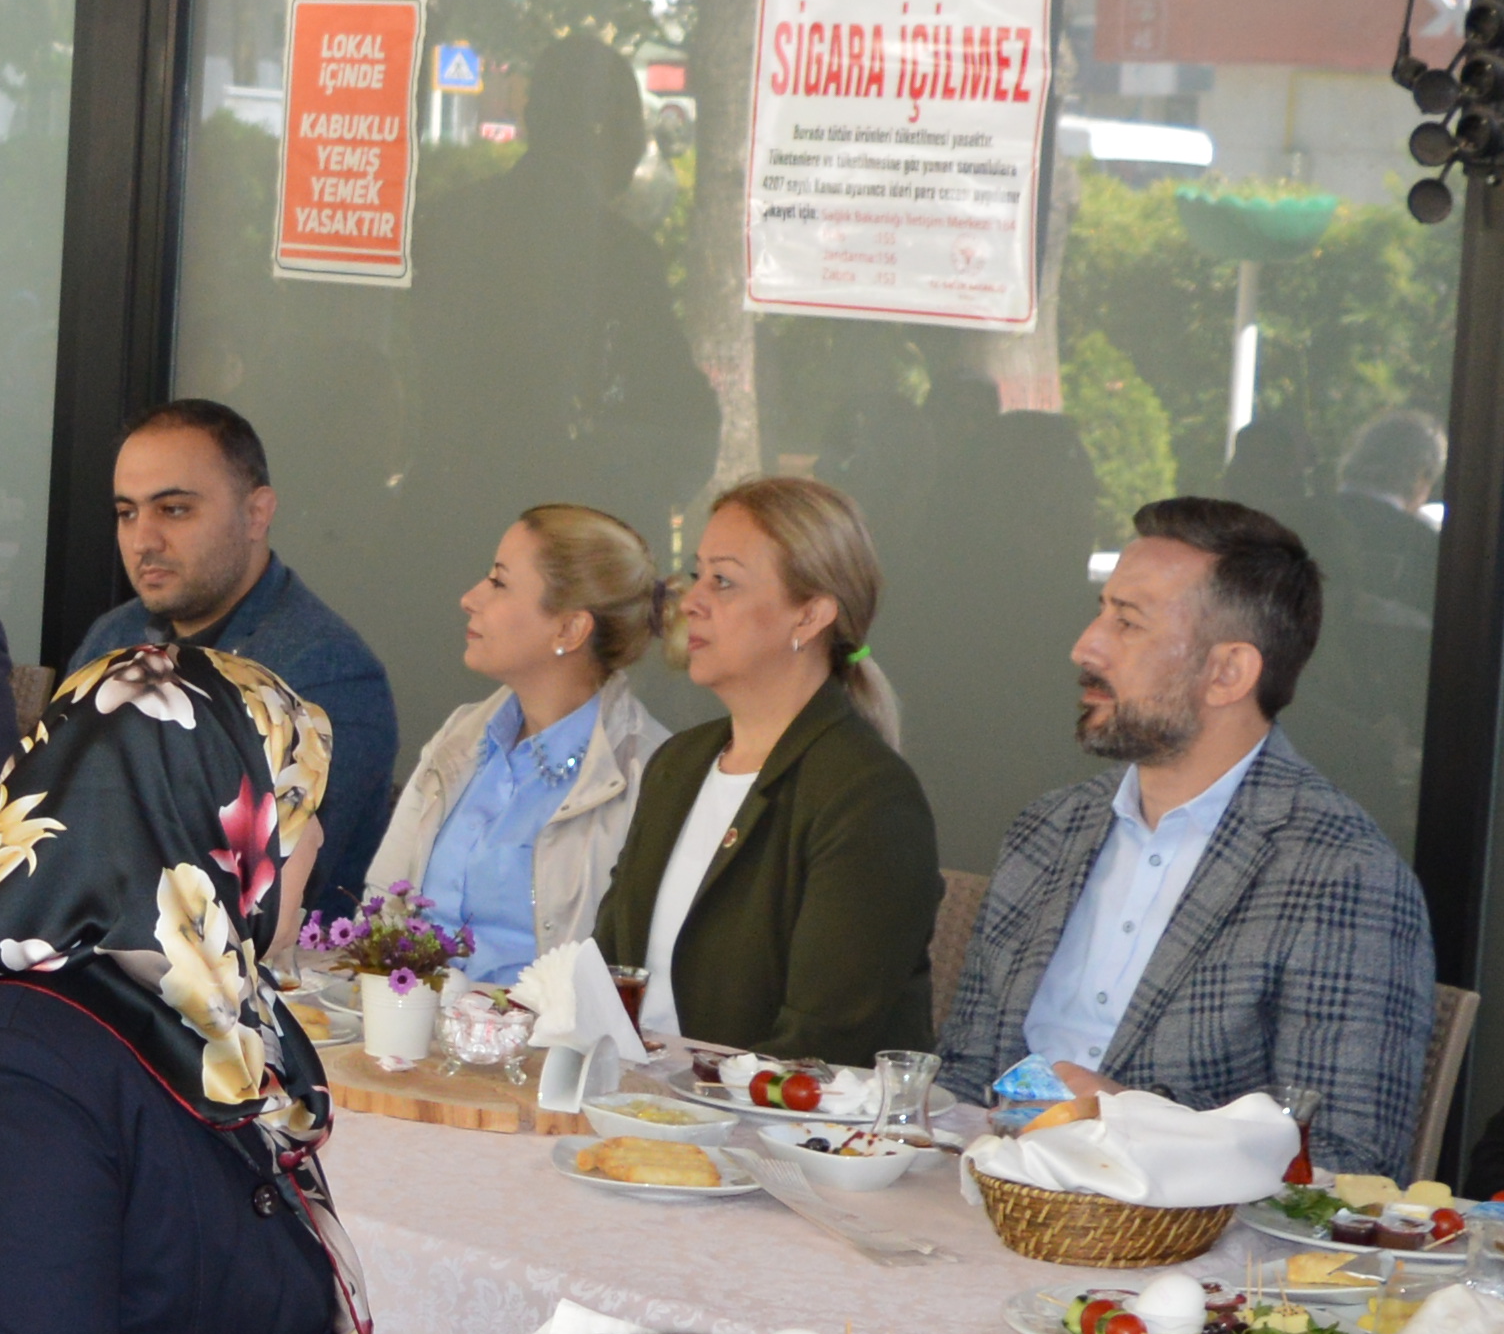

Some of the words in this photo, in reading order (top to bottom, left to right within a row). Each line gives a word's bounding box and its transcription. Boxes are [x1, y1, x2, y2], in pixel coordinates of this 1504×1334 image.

[321, 33, 385, 59] LOKAL
[771, 0, 886, 98] SİGARA
[896, 1, 1033, 123] İÇİLMEZ
[299, 112, 400, 142] KABUKLU
[311, 176, 384, 205] YEMEK
[295, 206, 396, 238] YASAKTIR
